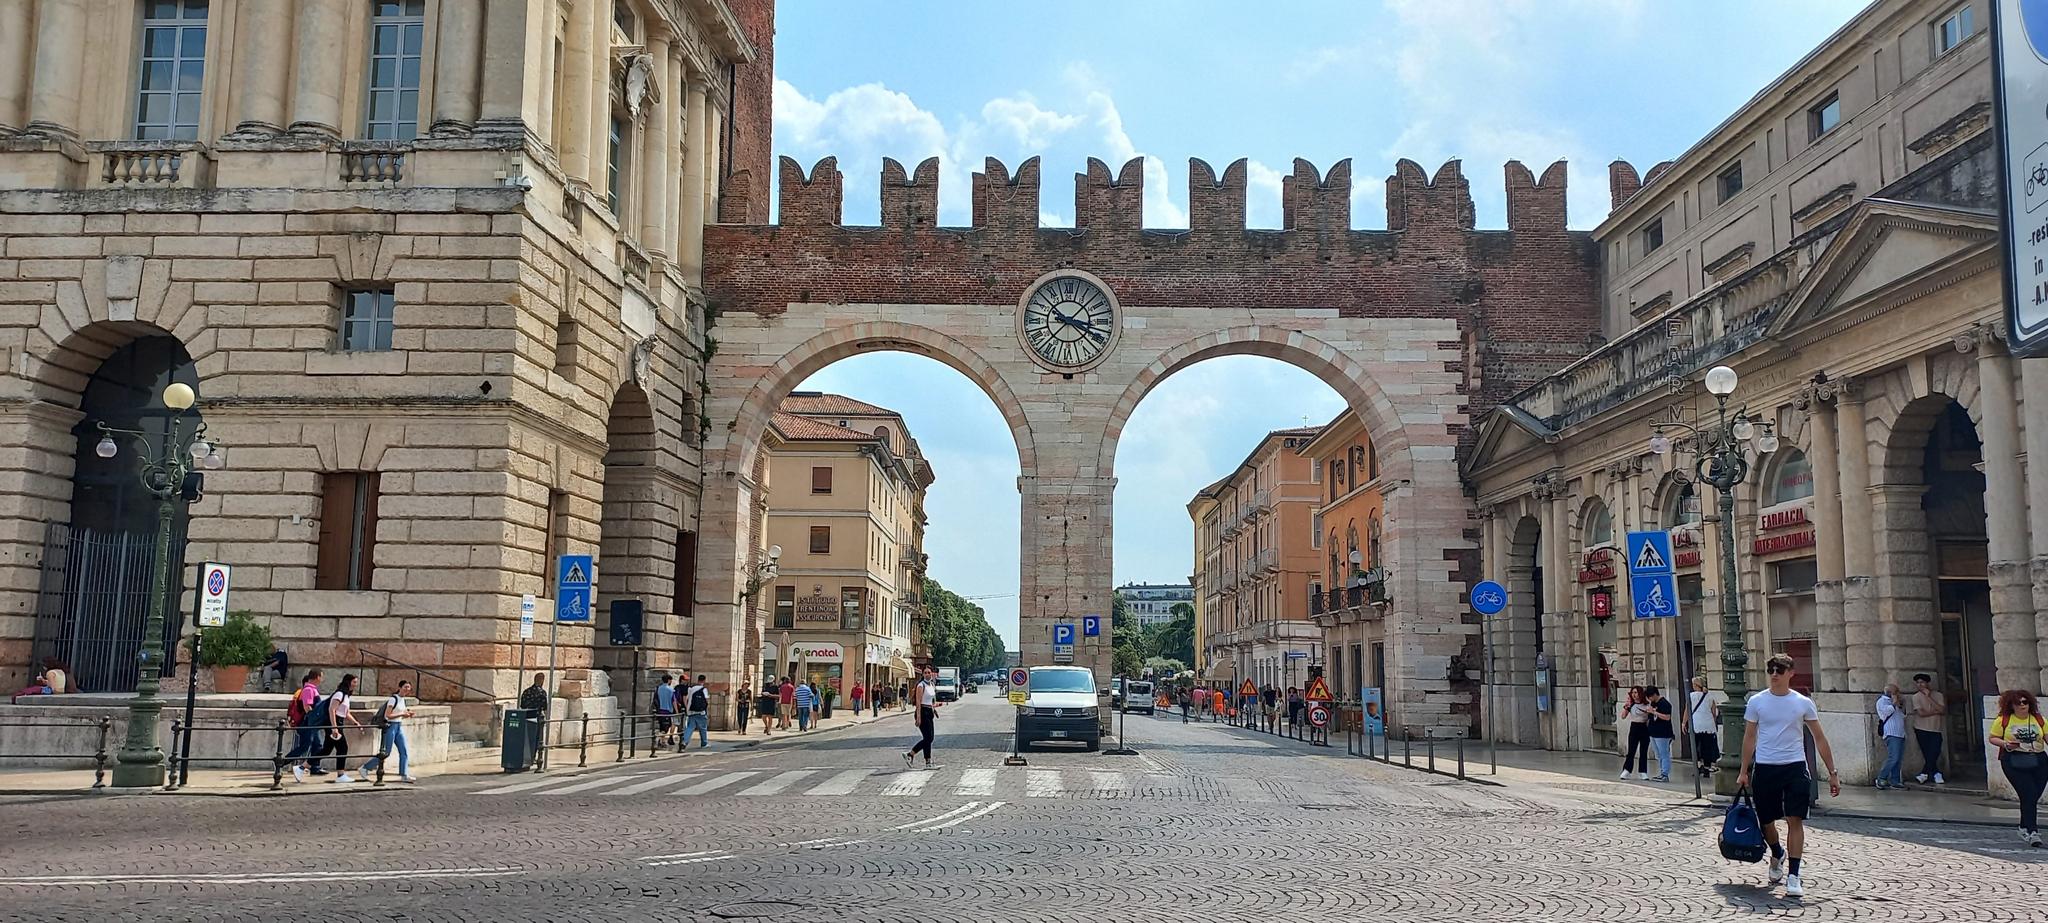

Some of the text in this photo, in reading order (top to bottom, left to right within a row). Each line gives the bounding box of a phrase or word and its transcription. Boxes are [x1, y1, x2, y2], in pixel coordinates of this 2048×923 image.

[2034, 256, 2044, 276] in
[1762, 508, 1804, 529] FARMACIA
[1058, 626, 1070, 643] P
[1086, 618, 1096, 634] P
[1314, 711, 1325, 721] 30
